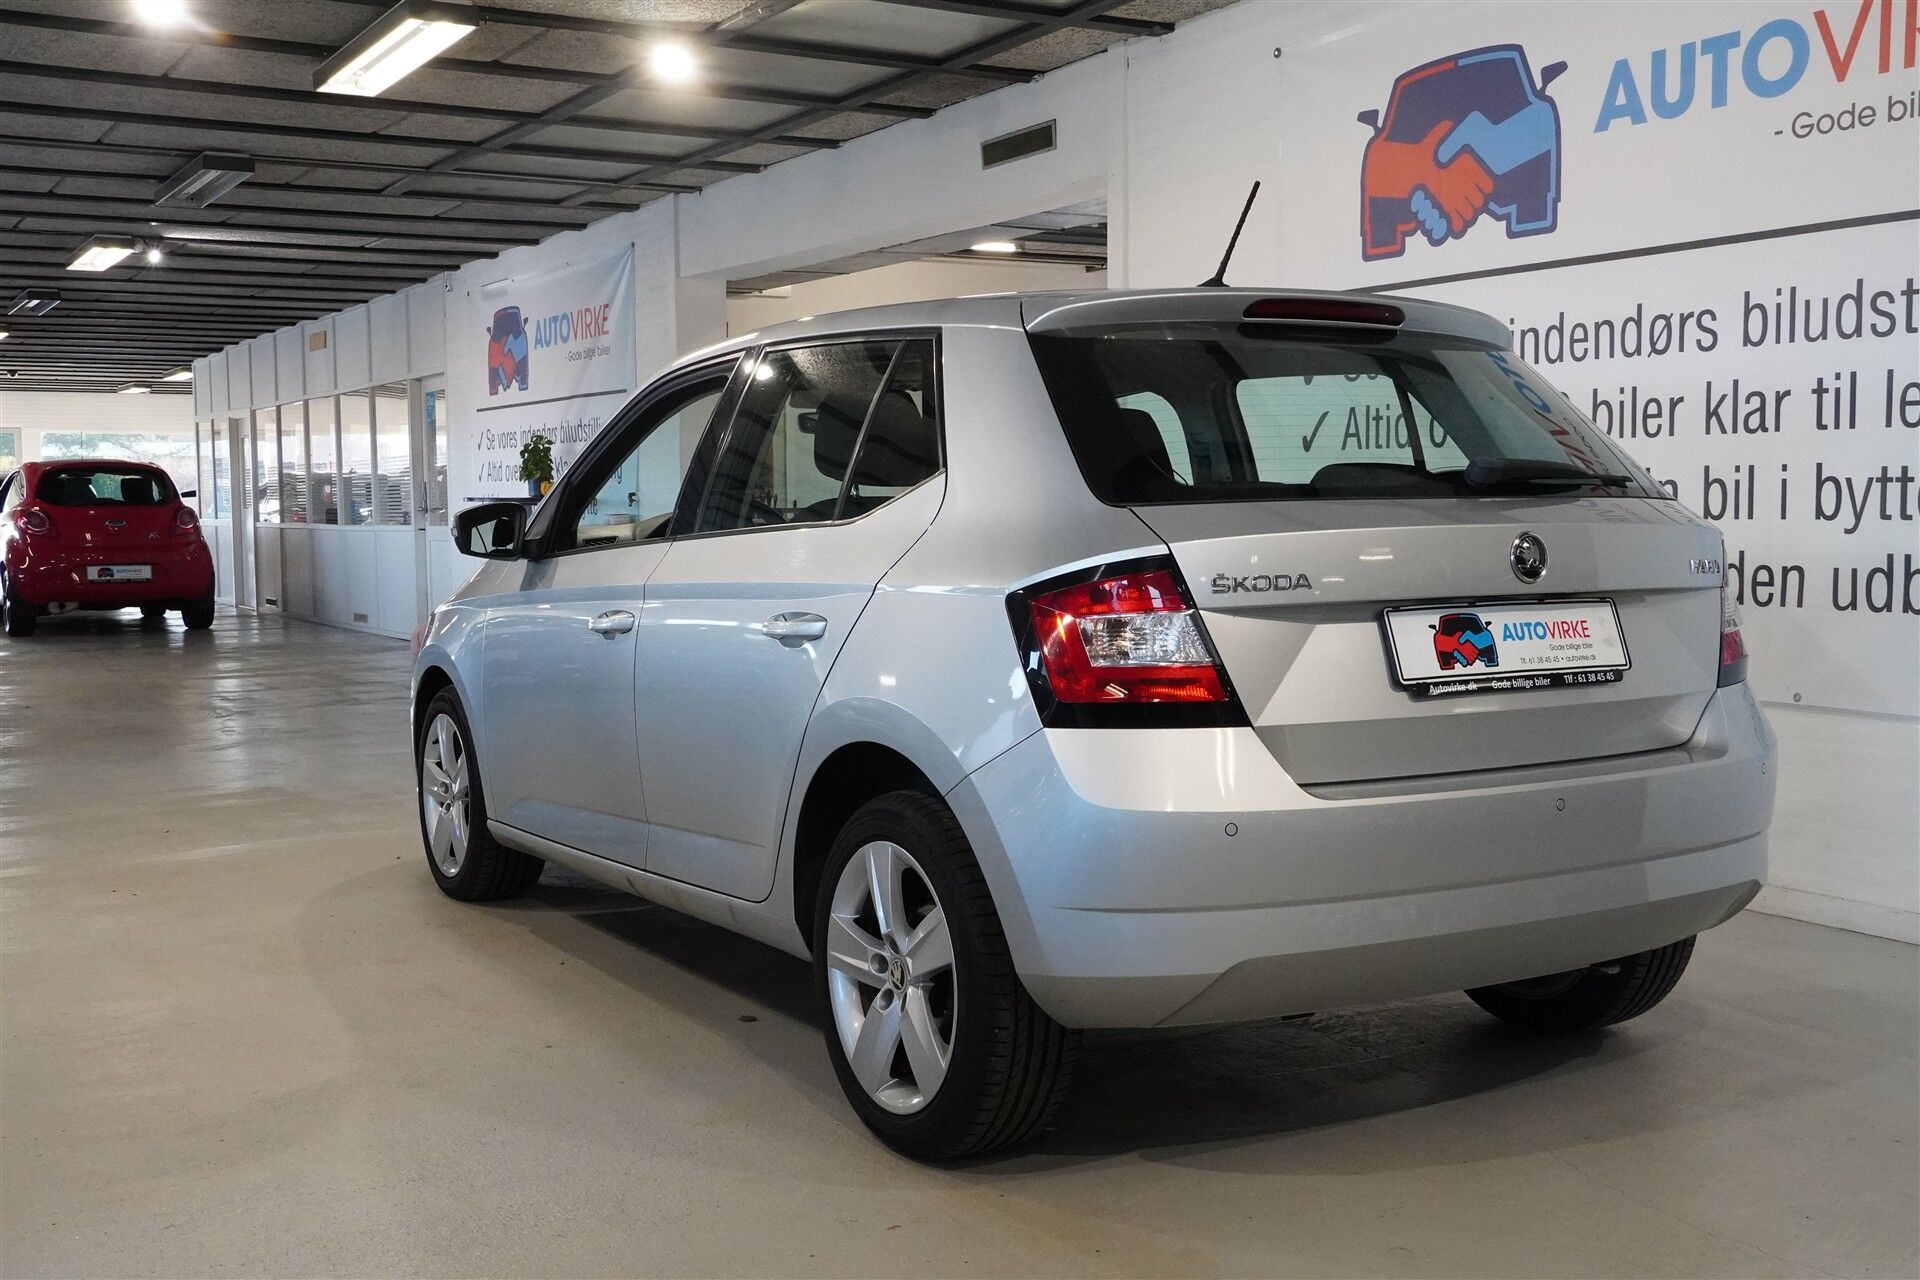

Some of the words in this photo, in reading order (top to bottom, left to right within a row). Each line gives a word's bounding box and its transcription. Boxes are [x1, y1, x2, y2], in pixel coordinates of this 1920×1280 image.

[1791, 102, 1877, 139] Gode
[1742, 278, 1920, 348] biludst
[534, 303, 610, 350] AUTOVIRKE
[1592, 386, 1684, 439] biler
[1705, 379, 1791, 436] klar
[1811, 370, 1857, 431] til
[486, 429, 496, 451] Se
[497, 431, 518, 449] vores
[487, 461, 503, 482] Altid
[1703, 465, 1755, 521] bil
[1780, 464, 1788, 520] i
[1815, 462, 1920, 535] bytt
[1211, 573, 1312, 594] ŠKODA
[1503, 620, 1591, 642] AUTOVIRKE
[1549, 643, 1565, 651] Gode
[1537, 656, 1544, 664] 38
[1553, 655, 1560, 663] 45
[1492, 680, 1511, 690] Gode
[1512, 678, 1534, 689] billige
[1535, 677, 1551, 687] biler
[1578, 674, 1587, 683] 61
[1588, 673, 1596, 682] 38
[1597, 673, 1605, 681] 45
[1606, 672, 1615, 681] 45
